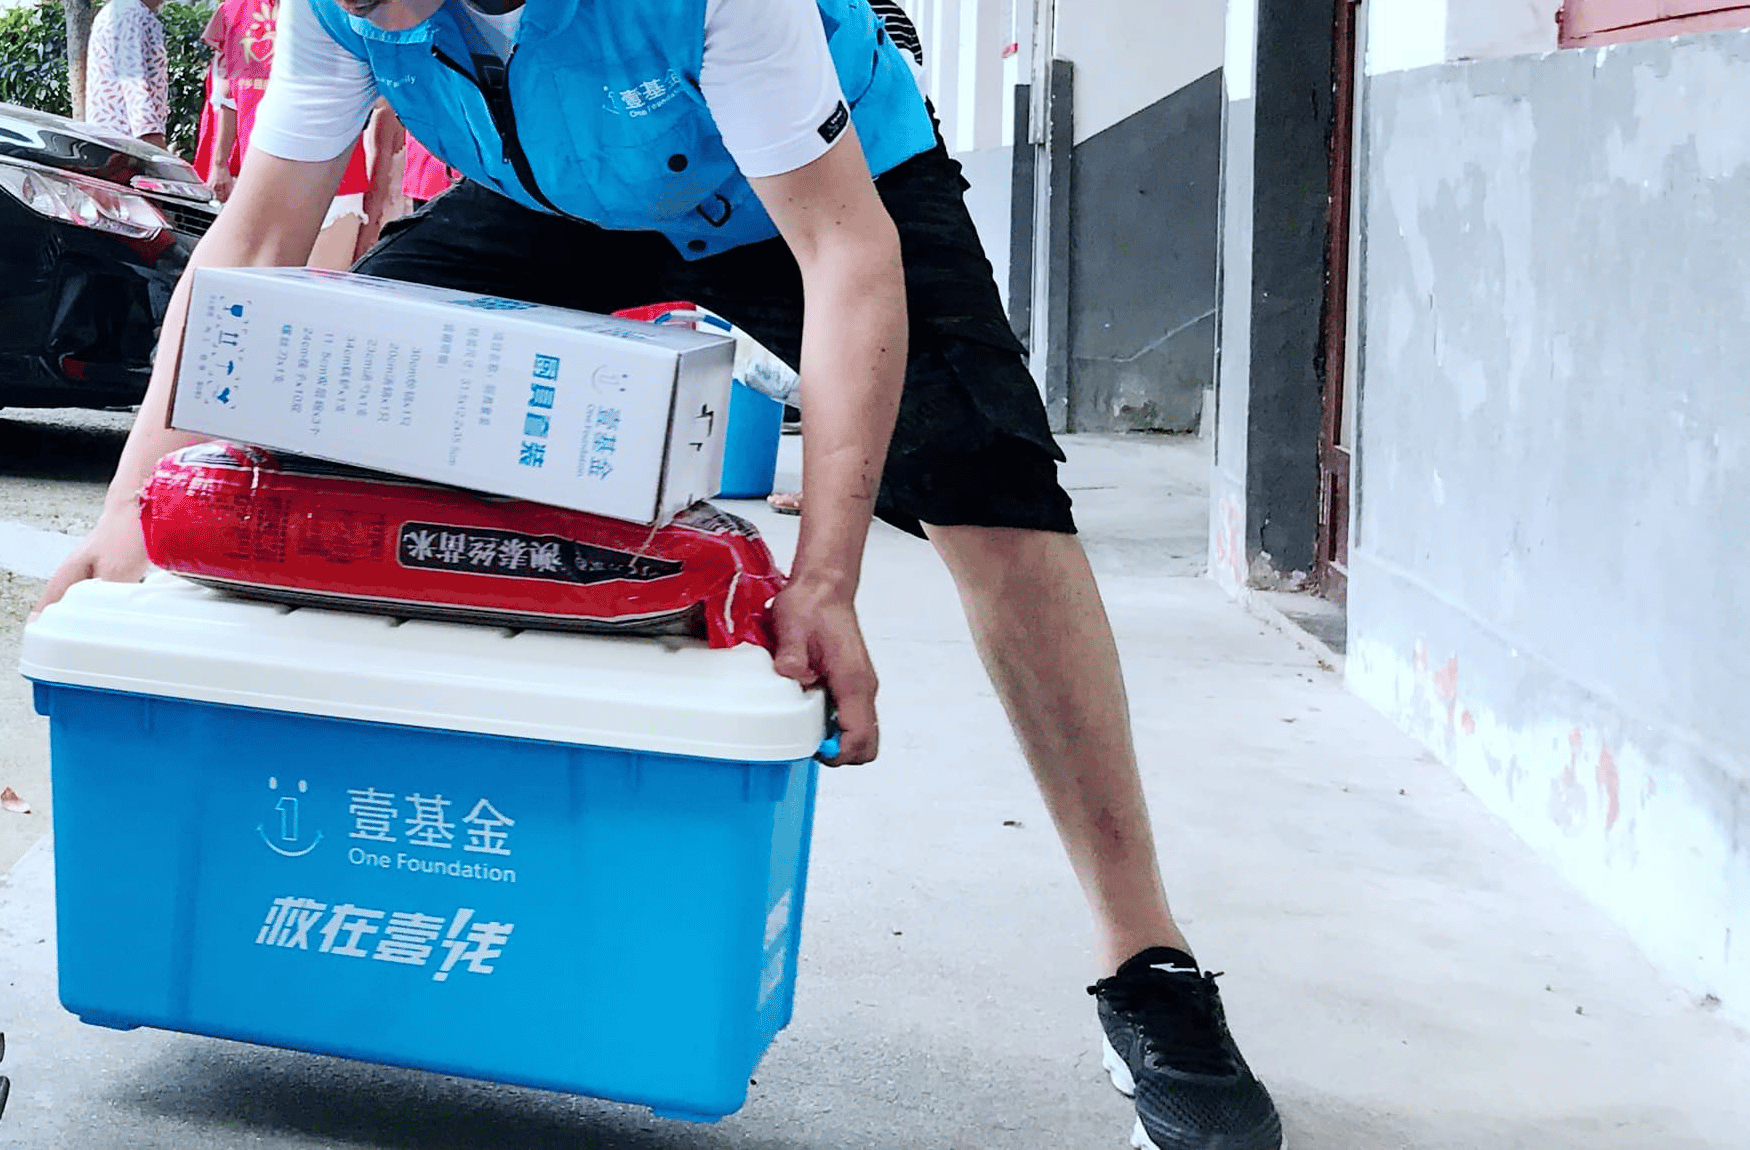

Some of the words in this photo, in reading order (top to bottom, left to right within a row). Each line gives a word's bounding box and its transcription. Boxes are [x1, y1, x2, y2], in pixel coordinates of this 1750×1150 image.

[586, 404, 624, 483] 壹基金
[346, 786, 516, 857] 壹基金
[348, 846, 392, 870] One
[397, 852, 517, 883] Foundation
